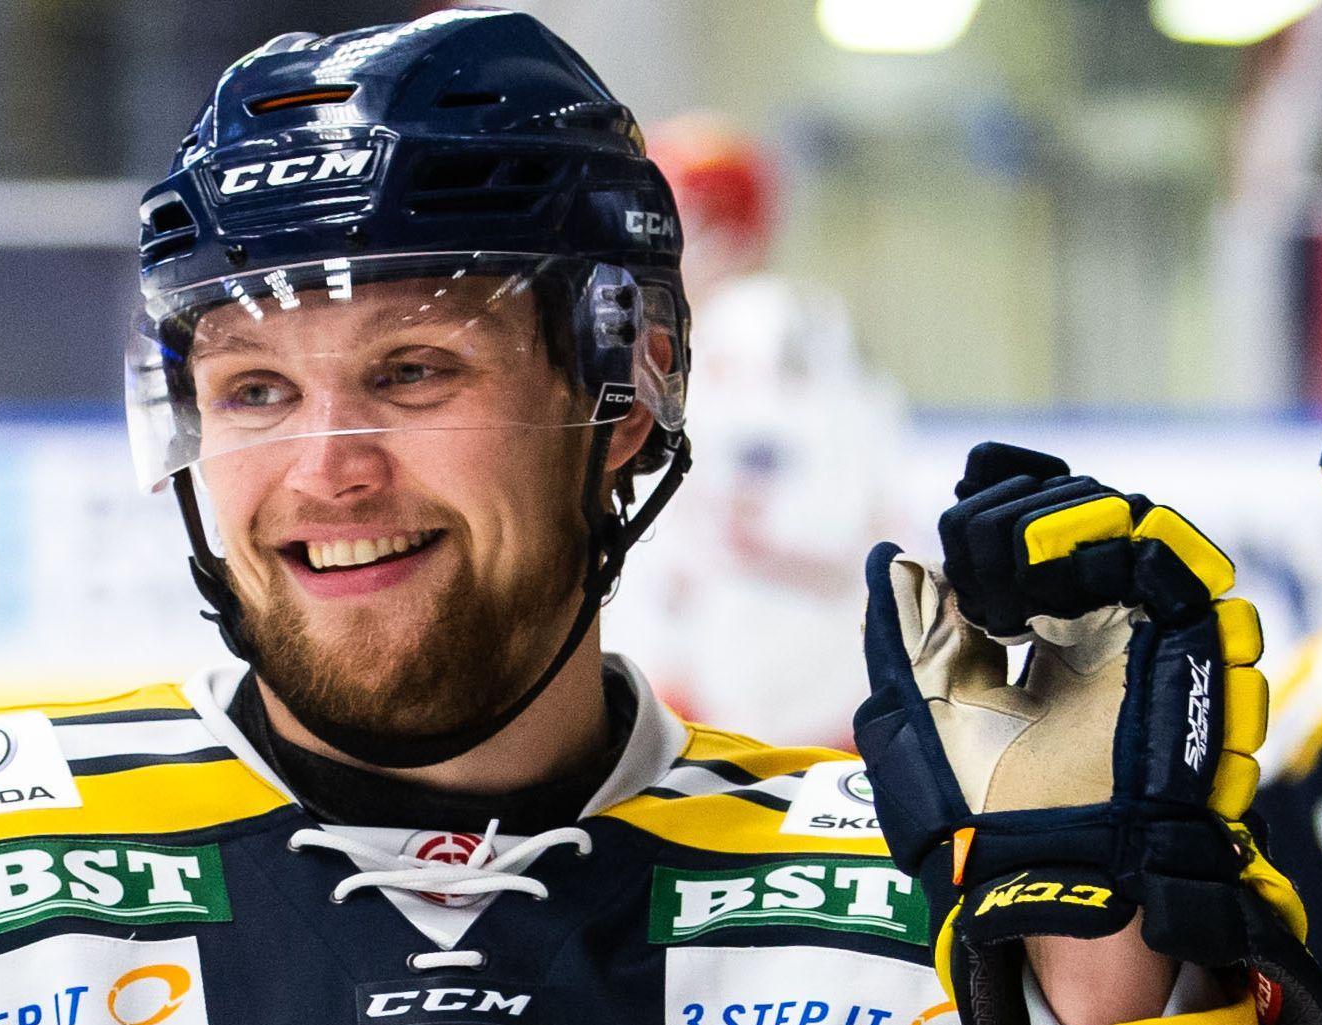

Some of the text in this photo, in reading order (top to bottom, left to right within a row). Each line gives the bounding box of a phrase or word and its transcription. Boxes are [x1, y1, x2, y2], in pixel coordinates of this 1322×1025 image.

[219, 148, 374, 195] CCM
[624, 210, 675, 238] CCM
[605, 393, 634, 403] CCM
[1184, 653, 1212, 773] TACKS
[672, 864, 914, 928] BST
[974, 880, 1114, 917] CCM
[365, 986, 533, 1018] CCM
